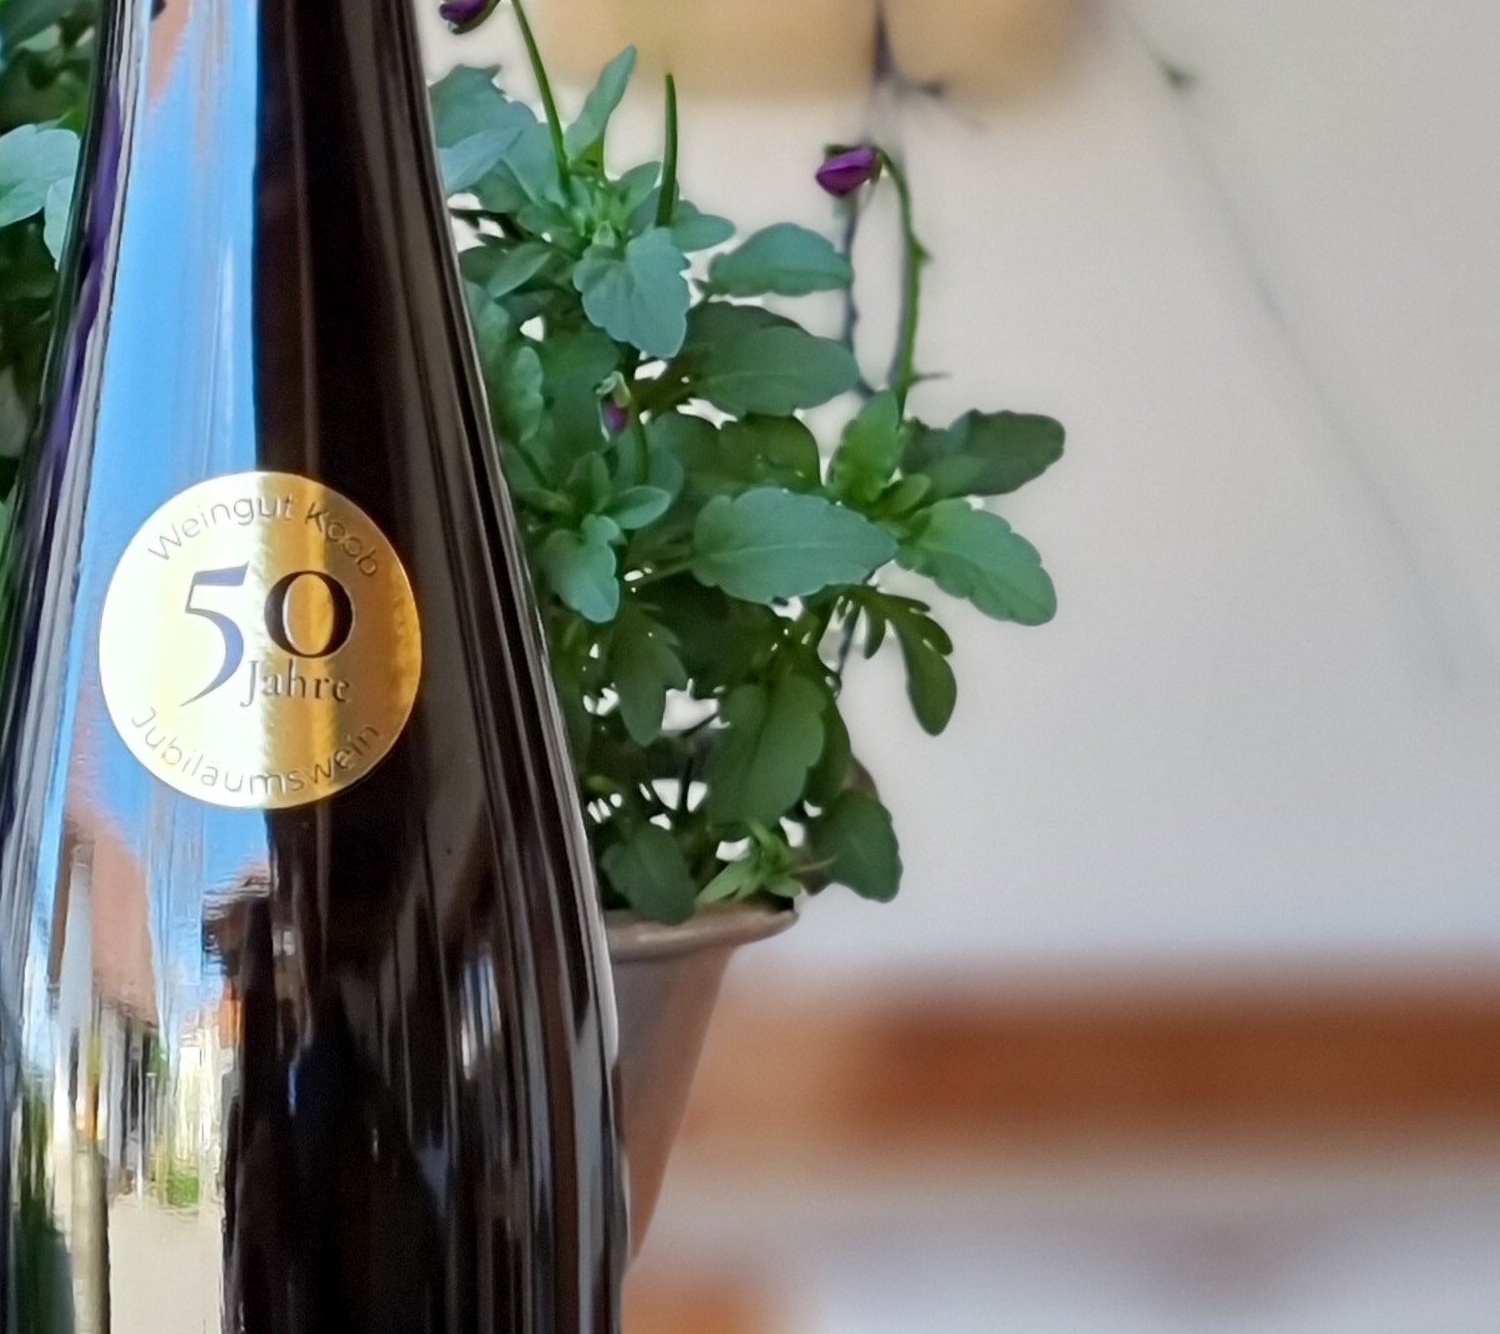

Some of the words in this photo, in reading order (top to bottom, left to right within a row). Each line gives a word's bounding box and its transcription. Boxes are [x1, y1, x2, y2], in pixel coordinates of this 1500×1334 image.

[147, 495, 294, 561] Weingut
[303, 501, 379, 578] Koob
[179, 560, 355, 707] 50
[239, 658, 351, 708] Jahre
